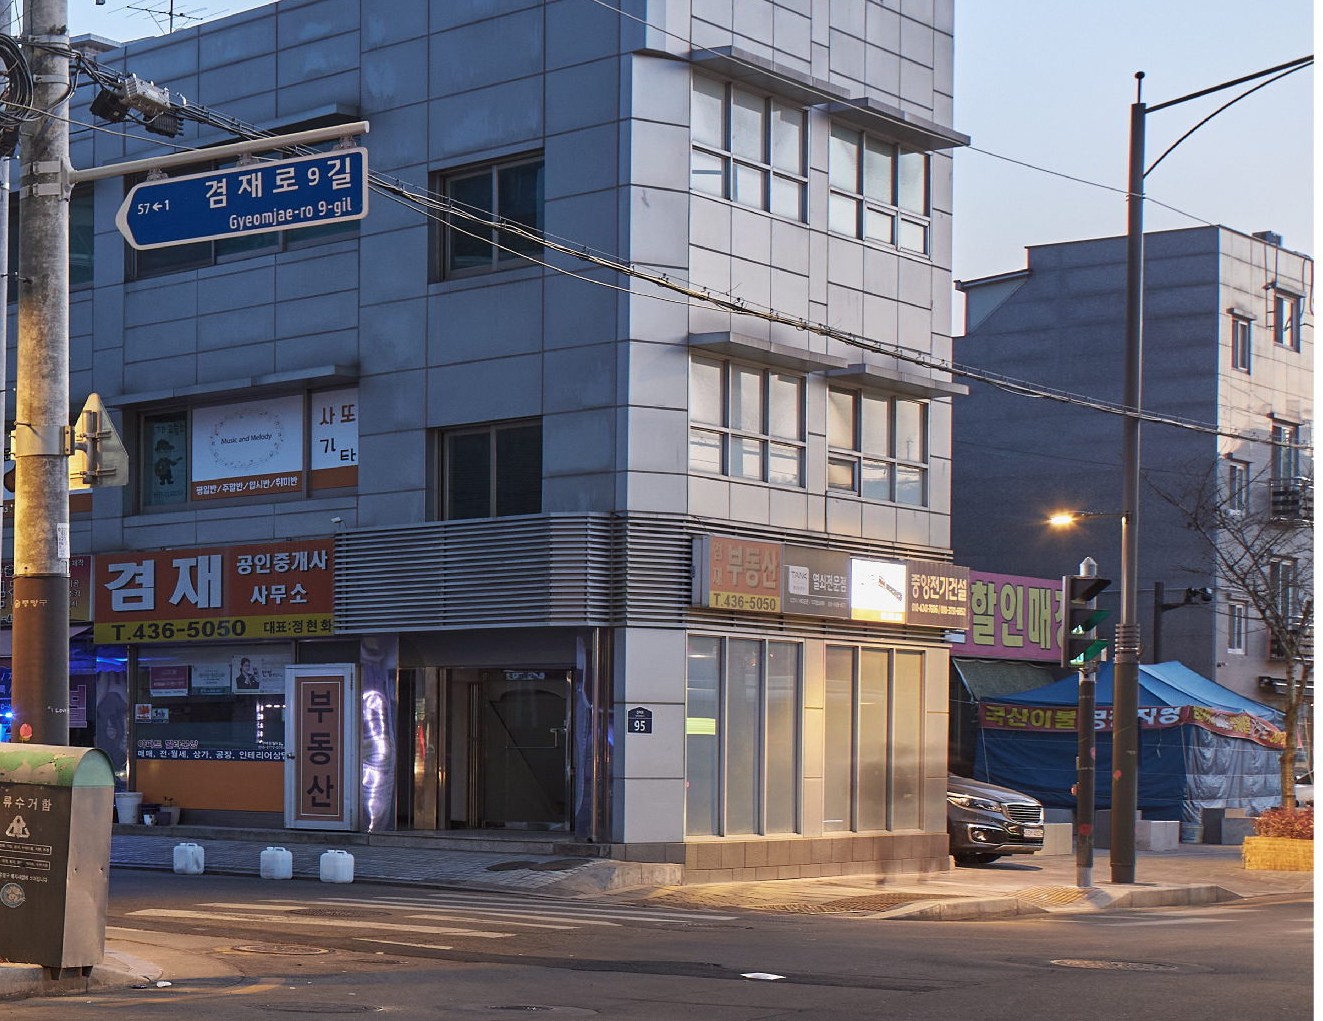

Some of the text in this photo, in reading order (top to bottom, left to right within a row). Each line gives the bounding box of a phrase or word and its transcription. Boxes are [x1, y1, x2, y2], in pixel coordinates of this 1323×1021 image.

[229, 197, 352, 230] Gyeomjae-ro 9-gil
[220, 433, 273, 445] Music and Melody
[236, 550, 328, 575] 공인중개사
[727, 544, 778, 590] 부동산
[250, 583, 308, 605] 사무소
[911, 573, 968, 602] 중앙전기건설
[713, 593, 777, 611] T.436-5050
[111, 619, 247, 642] T.436-5050
[634, 719, 646, 731] 95
[985, 705, 1078, 729] 국산이불
[306, 690, 334, 808] 부동산
